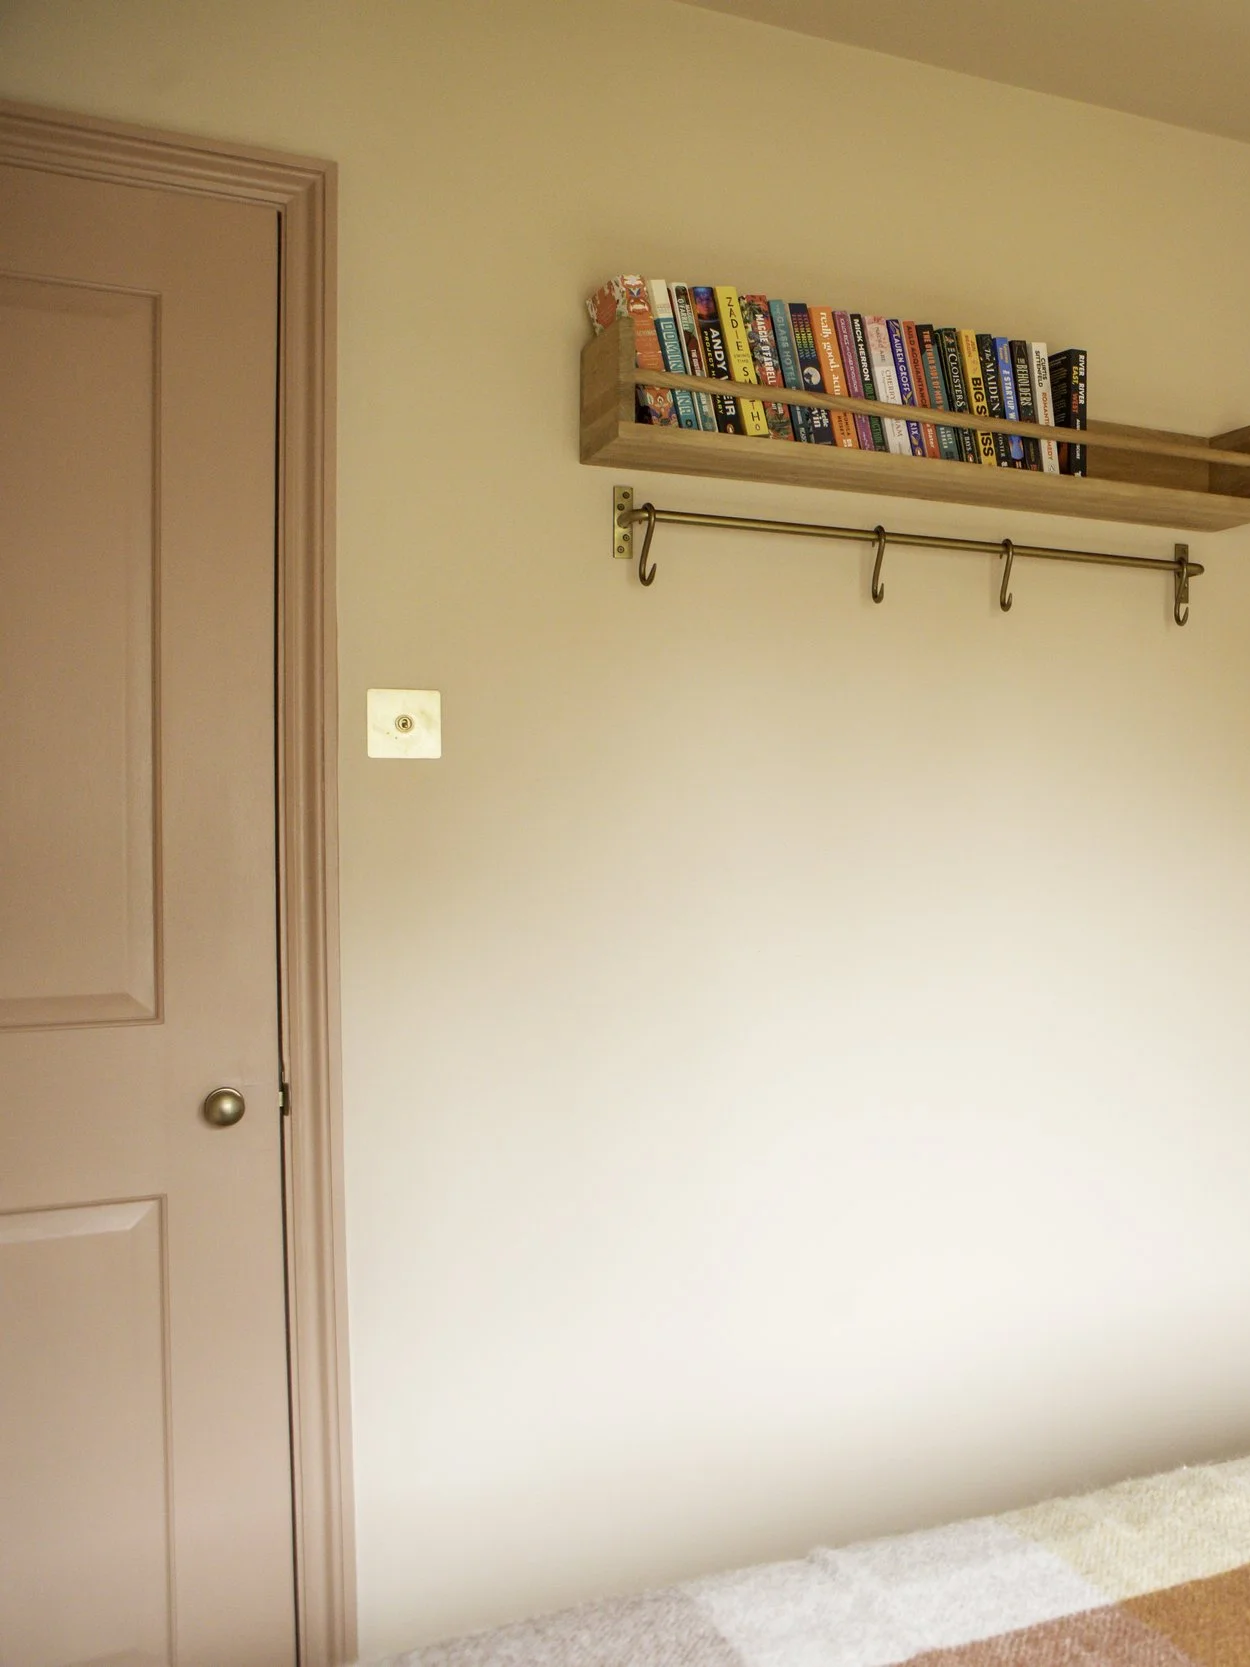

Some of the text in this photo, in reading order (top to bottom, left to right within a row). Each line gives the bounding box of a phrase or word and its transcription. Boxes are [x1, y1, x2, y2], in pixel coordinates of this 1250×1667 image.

[726, 296, 743, 351] ZADIE
[755, 313, 770, 342] MAGGIE
[777, 315, 790, 348] GLASS
[817, 311, 834, 338] really
[853, 318, 864, 342] MICK
[906, 325, 916, 345] AULD
[704, 330, 716, 368] PROJECT
[710, 327, 728, 372] ANDY
[761, 345, 778, 384] O'FARRELL
[783, 350, 797, 382] HOTEL
[823, 341, 841, 371] good,
[858, 343, 871, 381] HERRON
[892, 333, 912, 392] LAUREN GROFF
[922, 330, 932, 342] THE
[932, 380, 942, 389] OF
[660, 321, 695, 416] DOMINANA
[885, 369, 898, 401] CHERRY
[947, 352, 968, 407] CLOISTERS
[985, 361, 1002, 411] MAIDEN
[1016, 363, 1033, 406] BEHOLDERS
[1035, 350, 1044, 387] SITTENFELD
[1041, 357, 1049, 380] CURTIS
[1003, 375, 1016, 409] STARTUP
[1042, 391, 1051, 426] ROMANTI
[971, 376, 995, 457] BIG SISS
[946, 429, 955, 444] LUCY
